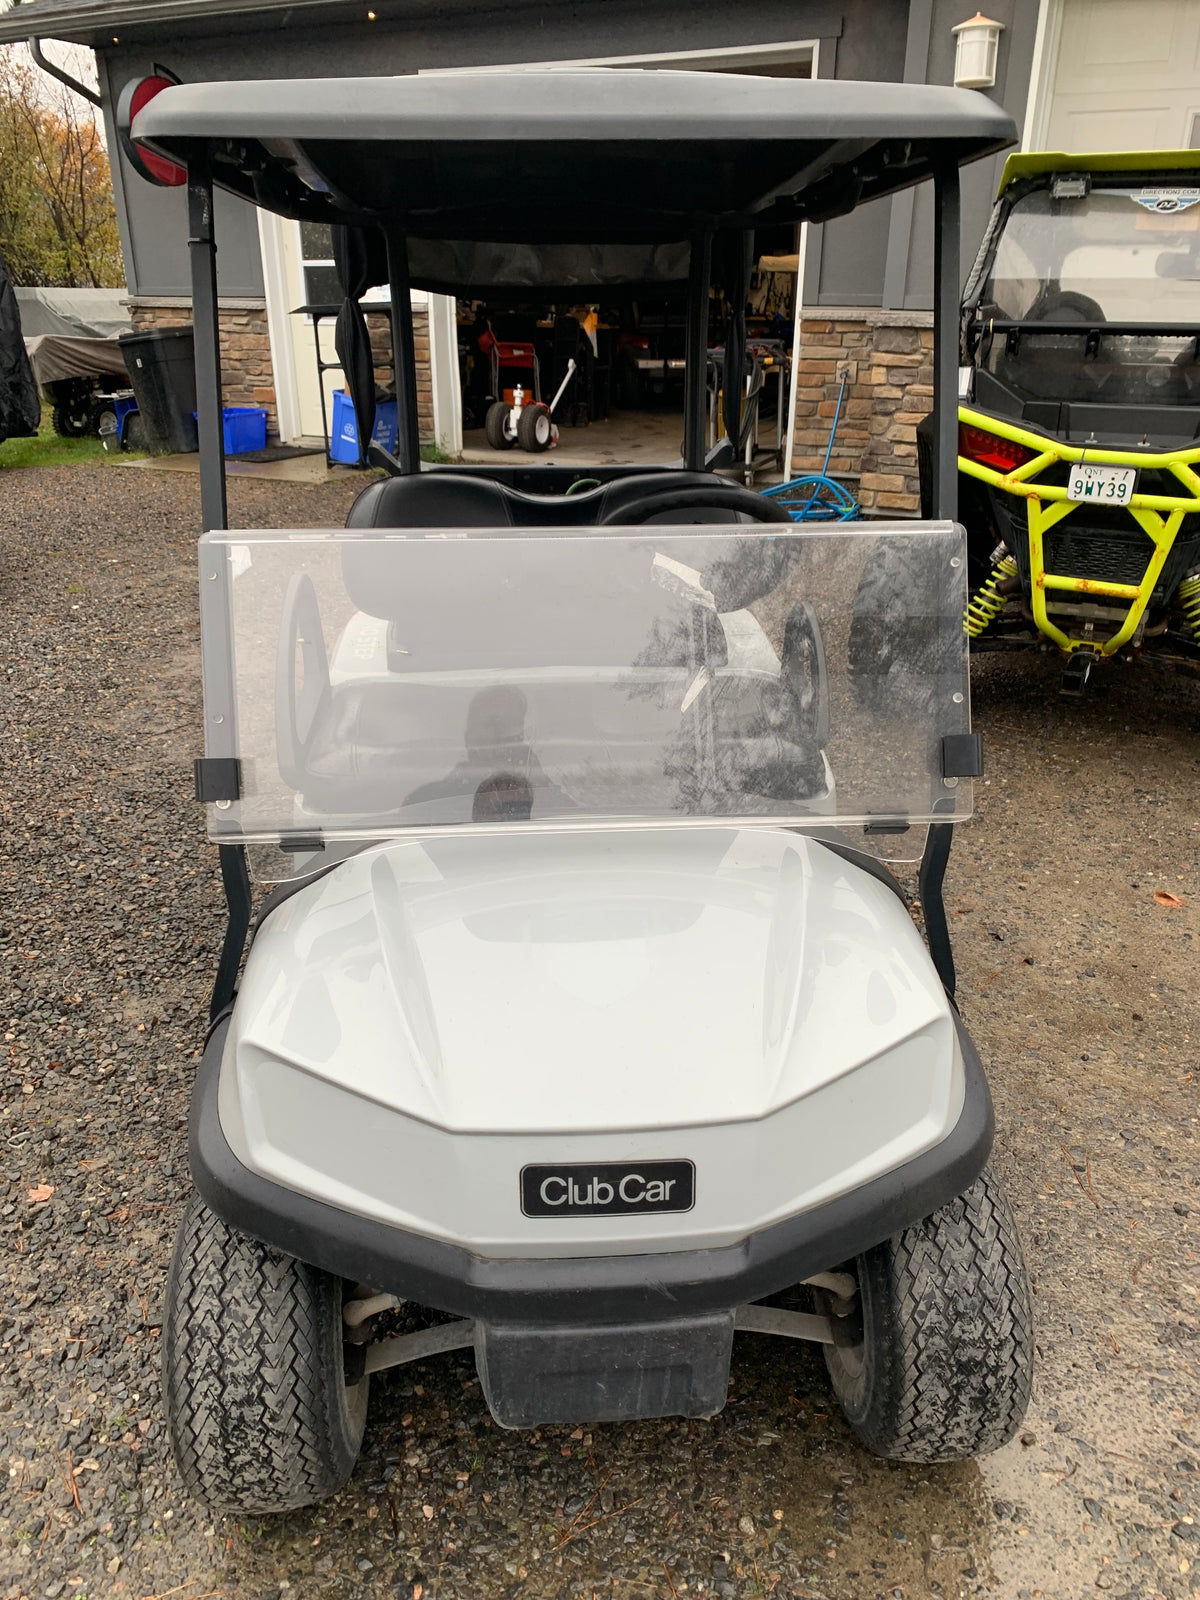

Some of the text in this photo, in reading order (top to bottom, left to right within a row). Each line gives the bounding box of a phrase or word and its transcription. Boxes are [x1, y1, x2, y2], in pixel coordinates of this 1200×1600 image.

[1073, 479, 1127, 498] 9WY39
[540, 1174, 676, 1206] Club Car
